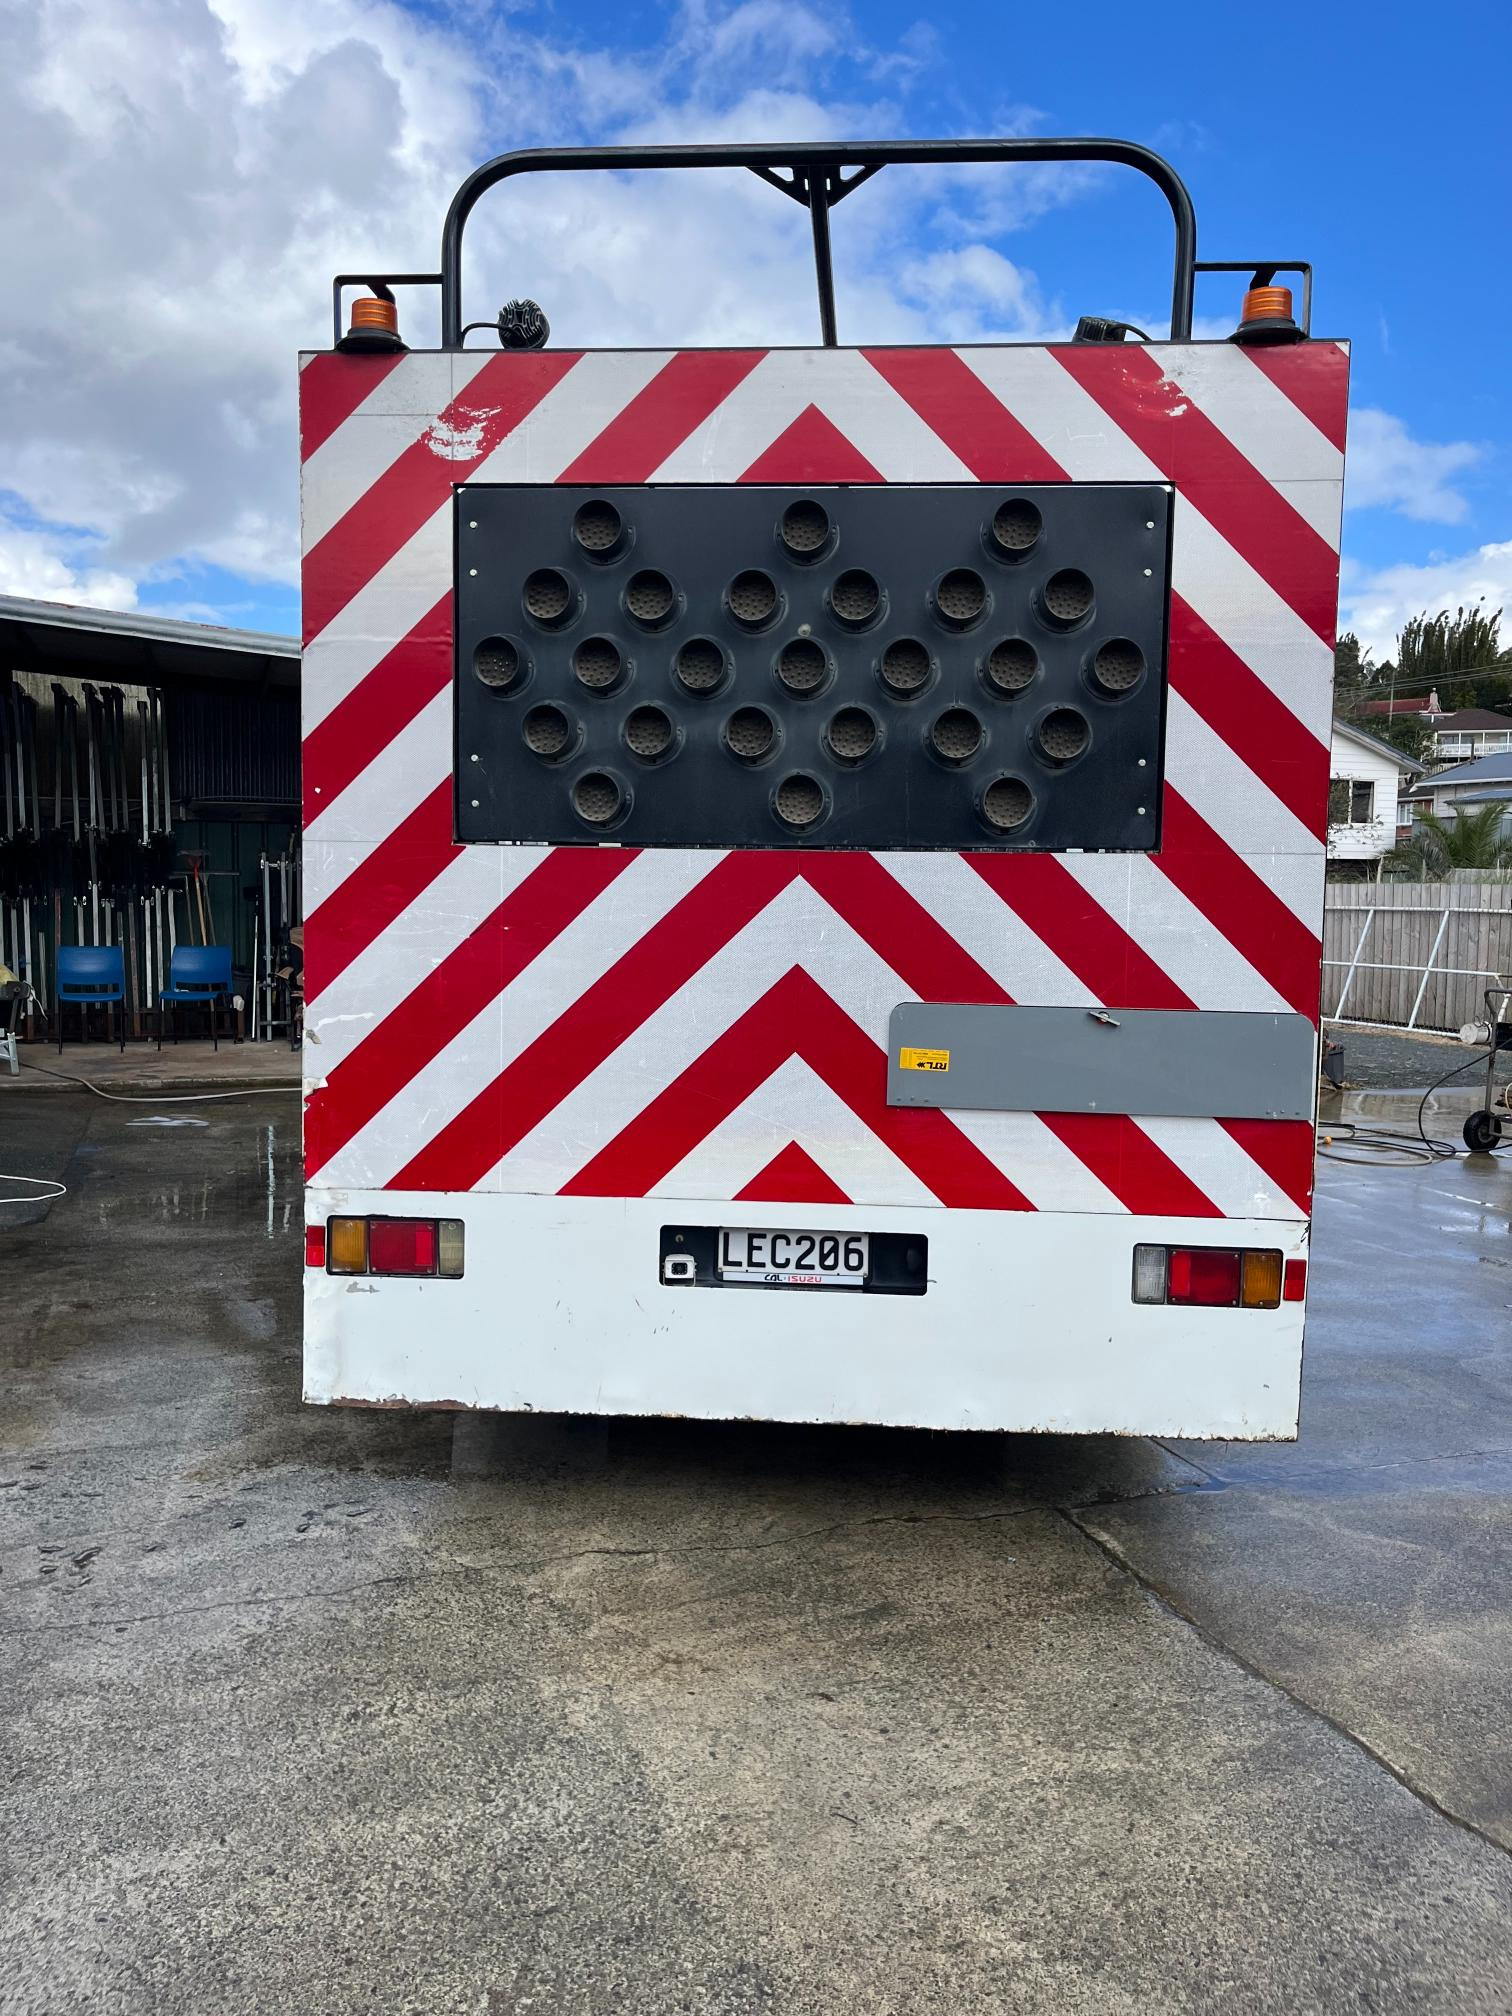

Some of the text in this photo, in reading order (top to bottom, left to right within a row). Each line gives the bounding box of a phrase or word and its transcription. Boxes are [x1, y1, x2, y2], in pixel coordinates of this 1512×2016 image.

[926, 1062, 947, 1070] RTL
[723, 1231, 864, 1271] LEC206
[787, 1275, 822, 1283] ISUZU
